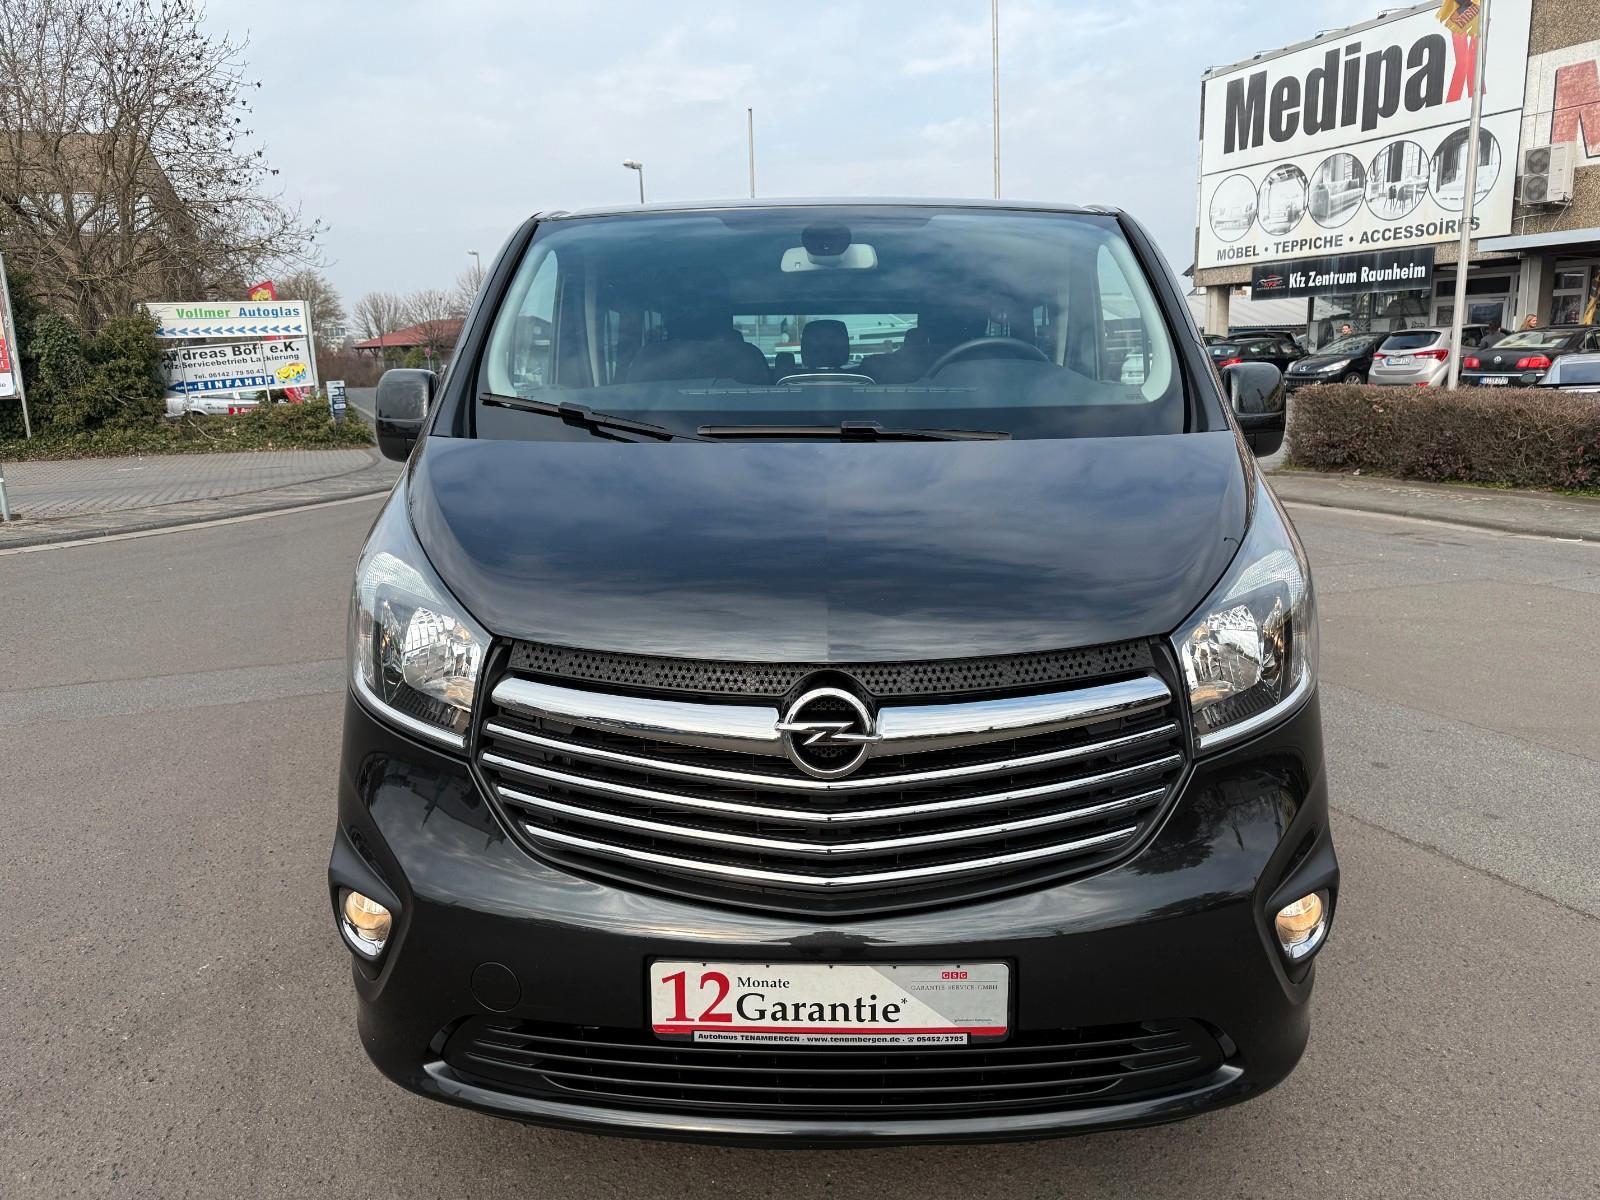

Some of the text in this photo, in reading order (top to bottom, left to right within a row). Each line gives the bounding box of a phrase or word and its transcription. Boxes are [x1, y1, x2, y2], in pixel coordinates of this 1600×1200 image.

[1224, 31, 1487, 154] Medipax
[1217, 245, 1259, 261] MÖBEL
[1274, 234, 1343, 254] TEPPICHE
[1289, 263, 1426, 288] Kfz Zentrum Raunheim
[176, 307, 300, 318] Vollmer Autoglas
[231, 344, 264, 357] Böf
[198, 376, 273, 390] EINFAHRT
[737, 976, 790, 989] Monate
[661, 970, 733, 1023] 12
[740, 1034, 800, 1042] TENAMBERGEN
